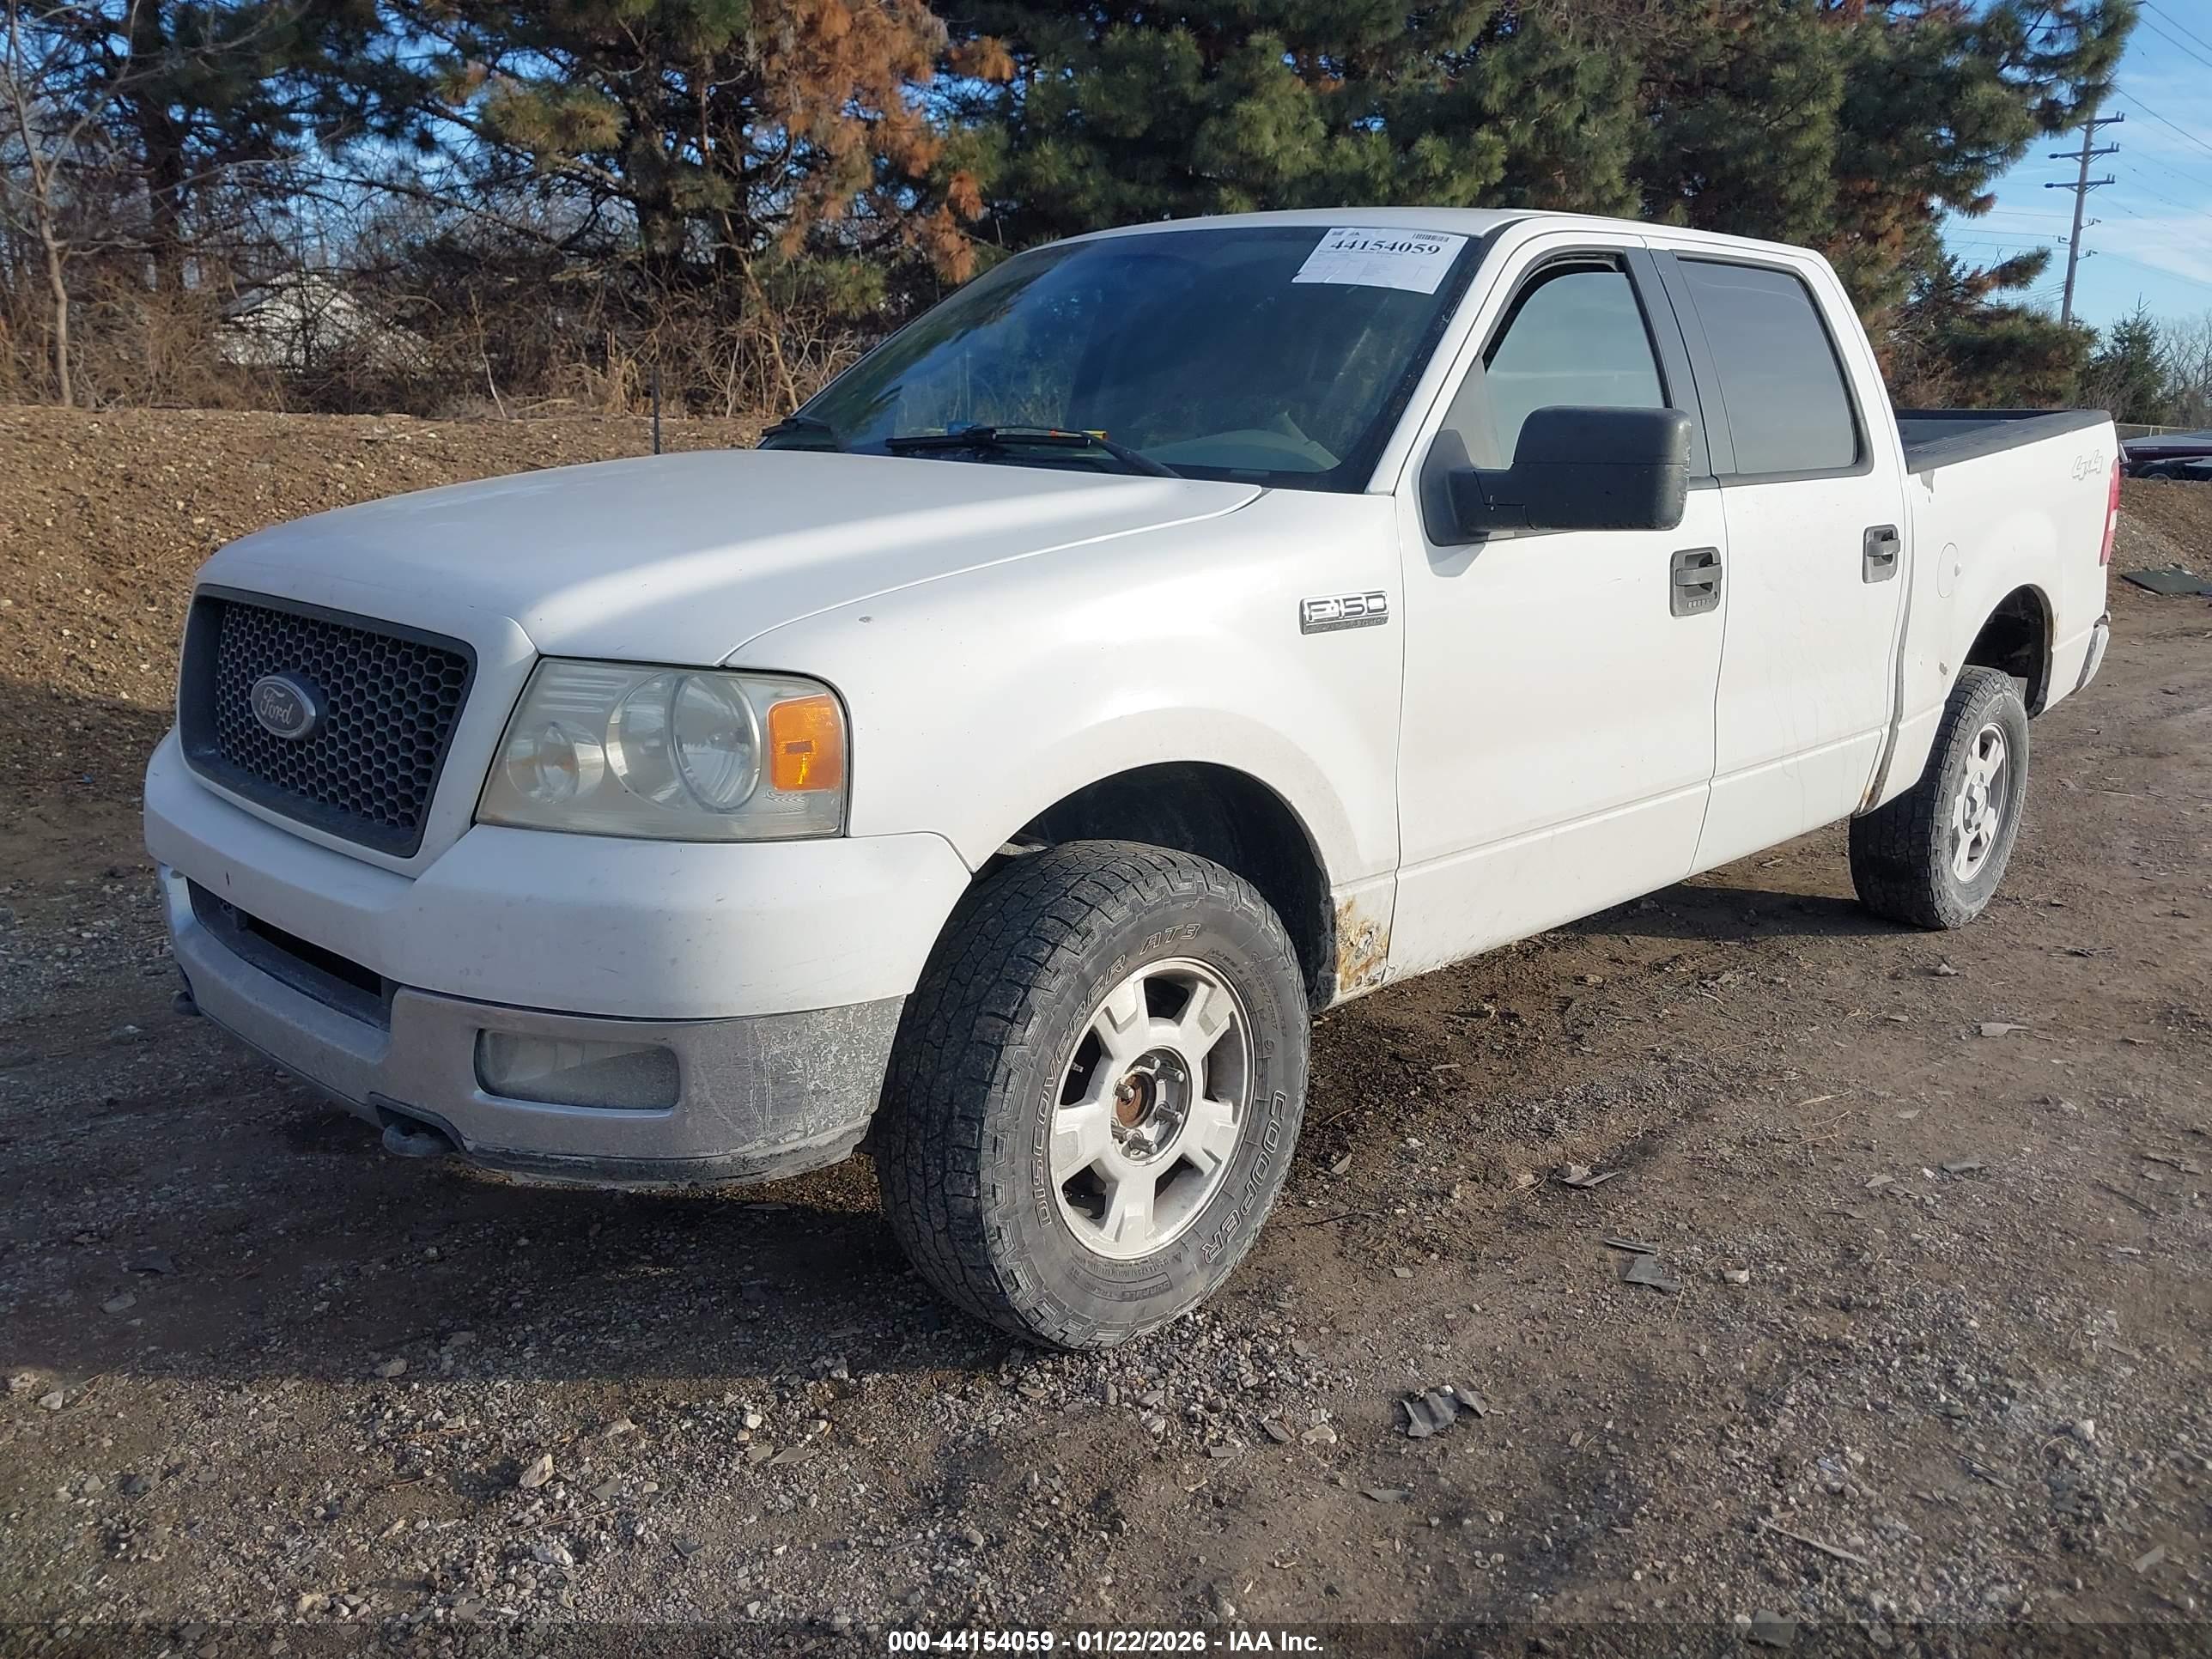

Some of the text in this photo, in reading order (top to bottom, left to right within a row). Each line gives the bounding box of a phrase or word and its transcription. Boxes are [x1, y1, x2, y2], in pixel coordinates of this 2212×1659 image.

[1330, 239, 1441, 256] 44154059
[2071, 449, 2103, 480] 4x4
[259, 686, 295, 725] Ford
[1032, 954, 1126, 1228] DISCOVERER
[1201, 1090, 1286, 1264] COOPER
